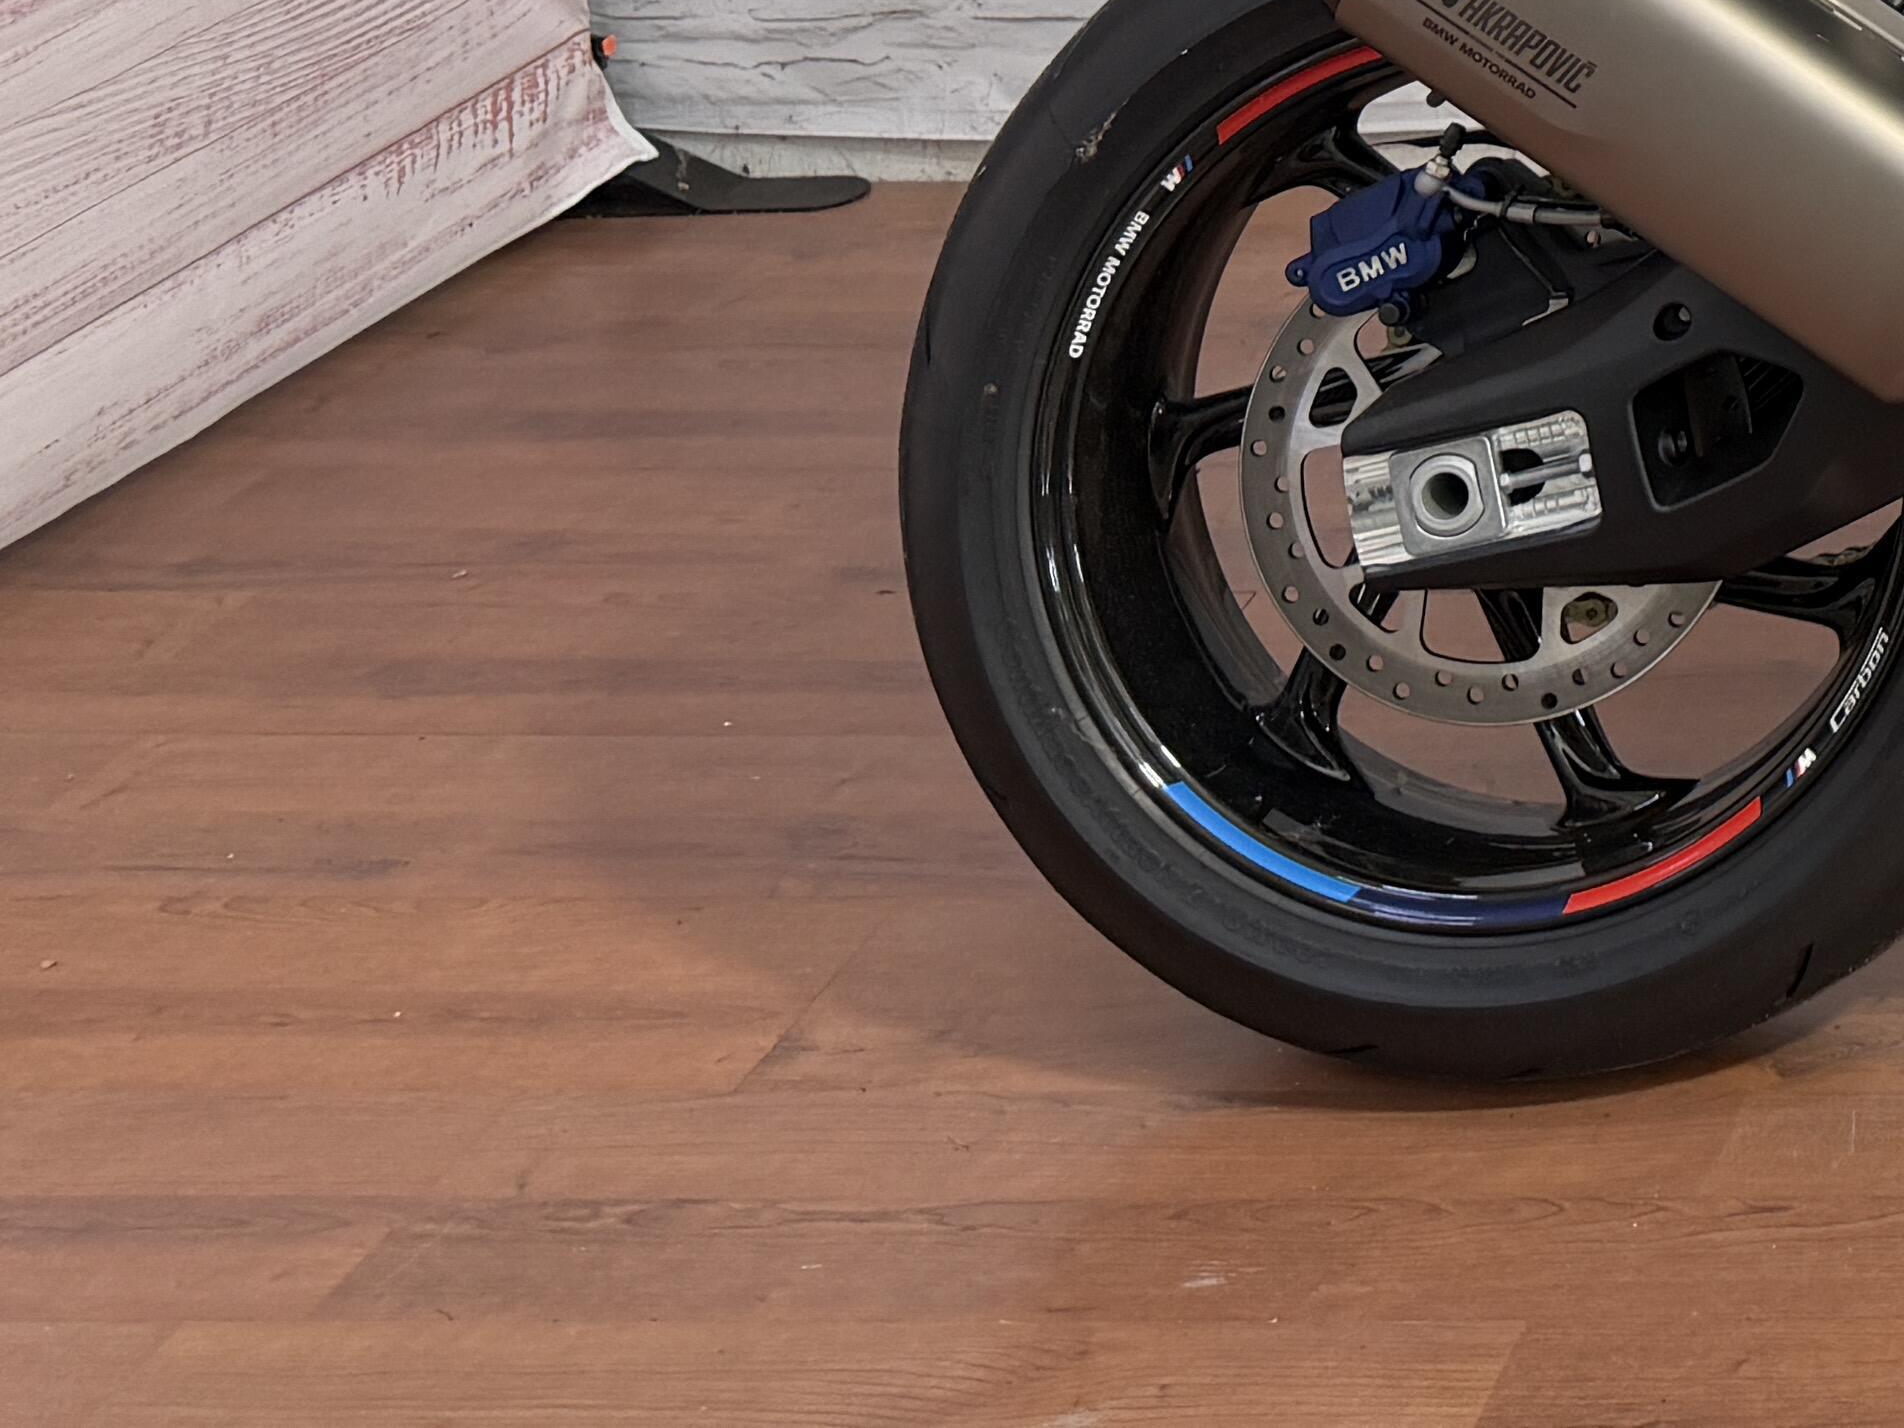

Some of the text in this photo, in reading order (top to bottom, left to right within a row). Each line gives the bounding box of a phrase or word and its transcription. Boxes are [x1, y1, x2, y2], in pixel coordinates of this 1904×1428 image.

[1421, 16, 1537, 100] BMW MOTORRAD
[1068, 210, 1151, 360] BMW MOTORRAD
[1336, 242, 1408, 293] BMW
[1829, 626, 1889, 734] Carbon
